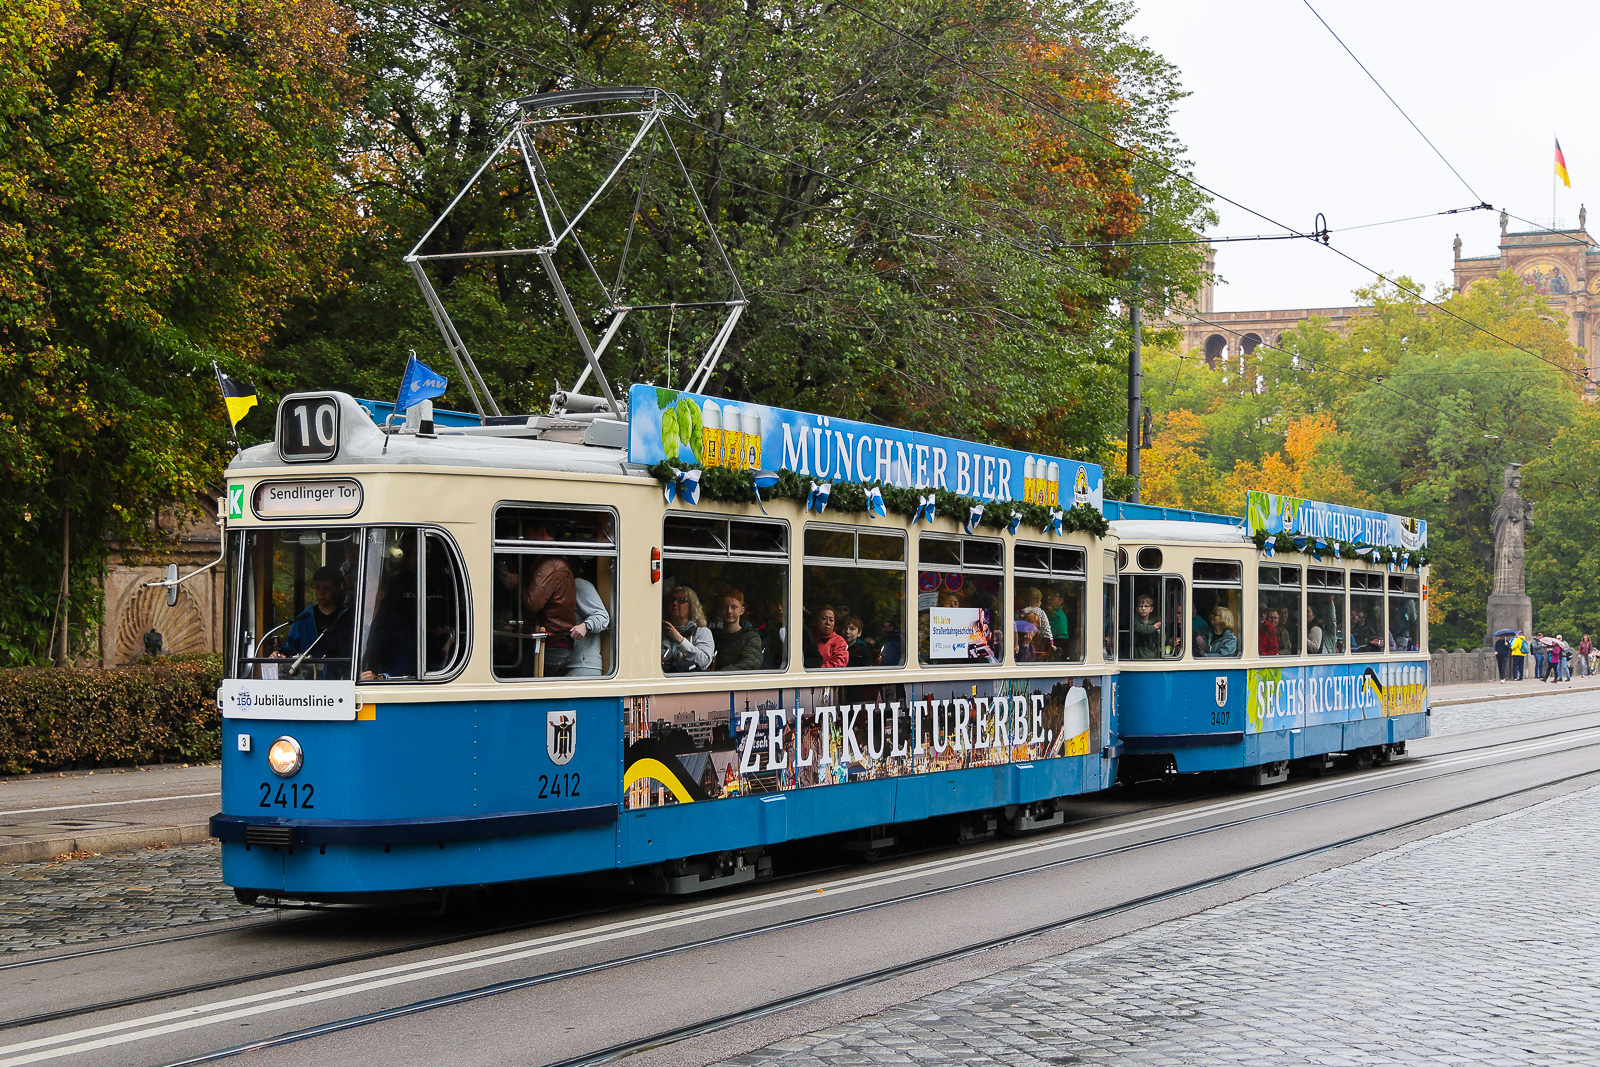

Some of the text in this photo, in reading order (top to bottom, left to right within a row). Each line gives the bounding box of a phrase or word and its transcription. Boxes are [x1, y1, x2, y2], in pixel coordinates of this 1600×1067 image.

[294, 405, 336, 446] 10
[781, 416, 1012, 501] MÜNCHNER BIER
[229, 488, 243, 515] K
[270, 485, 357, 503] Sendlinger Tor
[1299, 501, 1362, 543] MÜNCHNER
[1365, 517, 1388, 547] BIER
[237, 697, 252, 706] 150
[254, 694, 335, 707] Jubiläumslinie
[1257, 674, 1376, 720] SECHS RICHTIGE.
[1210, 711, 1230, 726] 3407
[242, 737, 247, 748] 3
[740, 695, 1052, 773] ZELTKULTURERBE.
[259, 782, 315, 809] 2412
[538, 772, 581, 799] 2412
